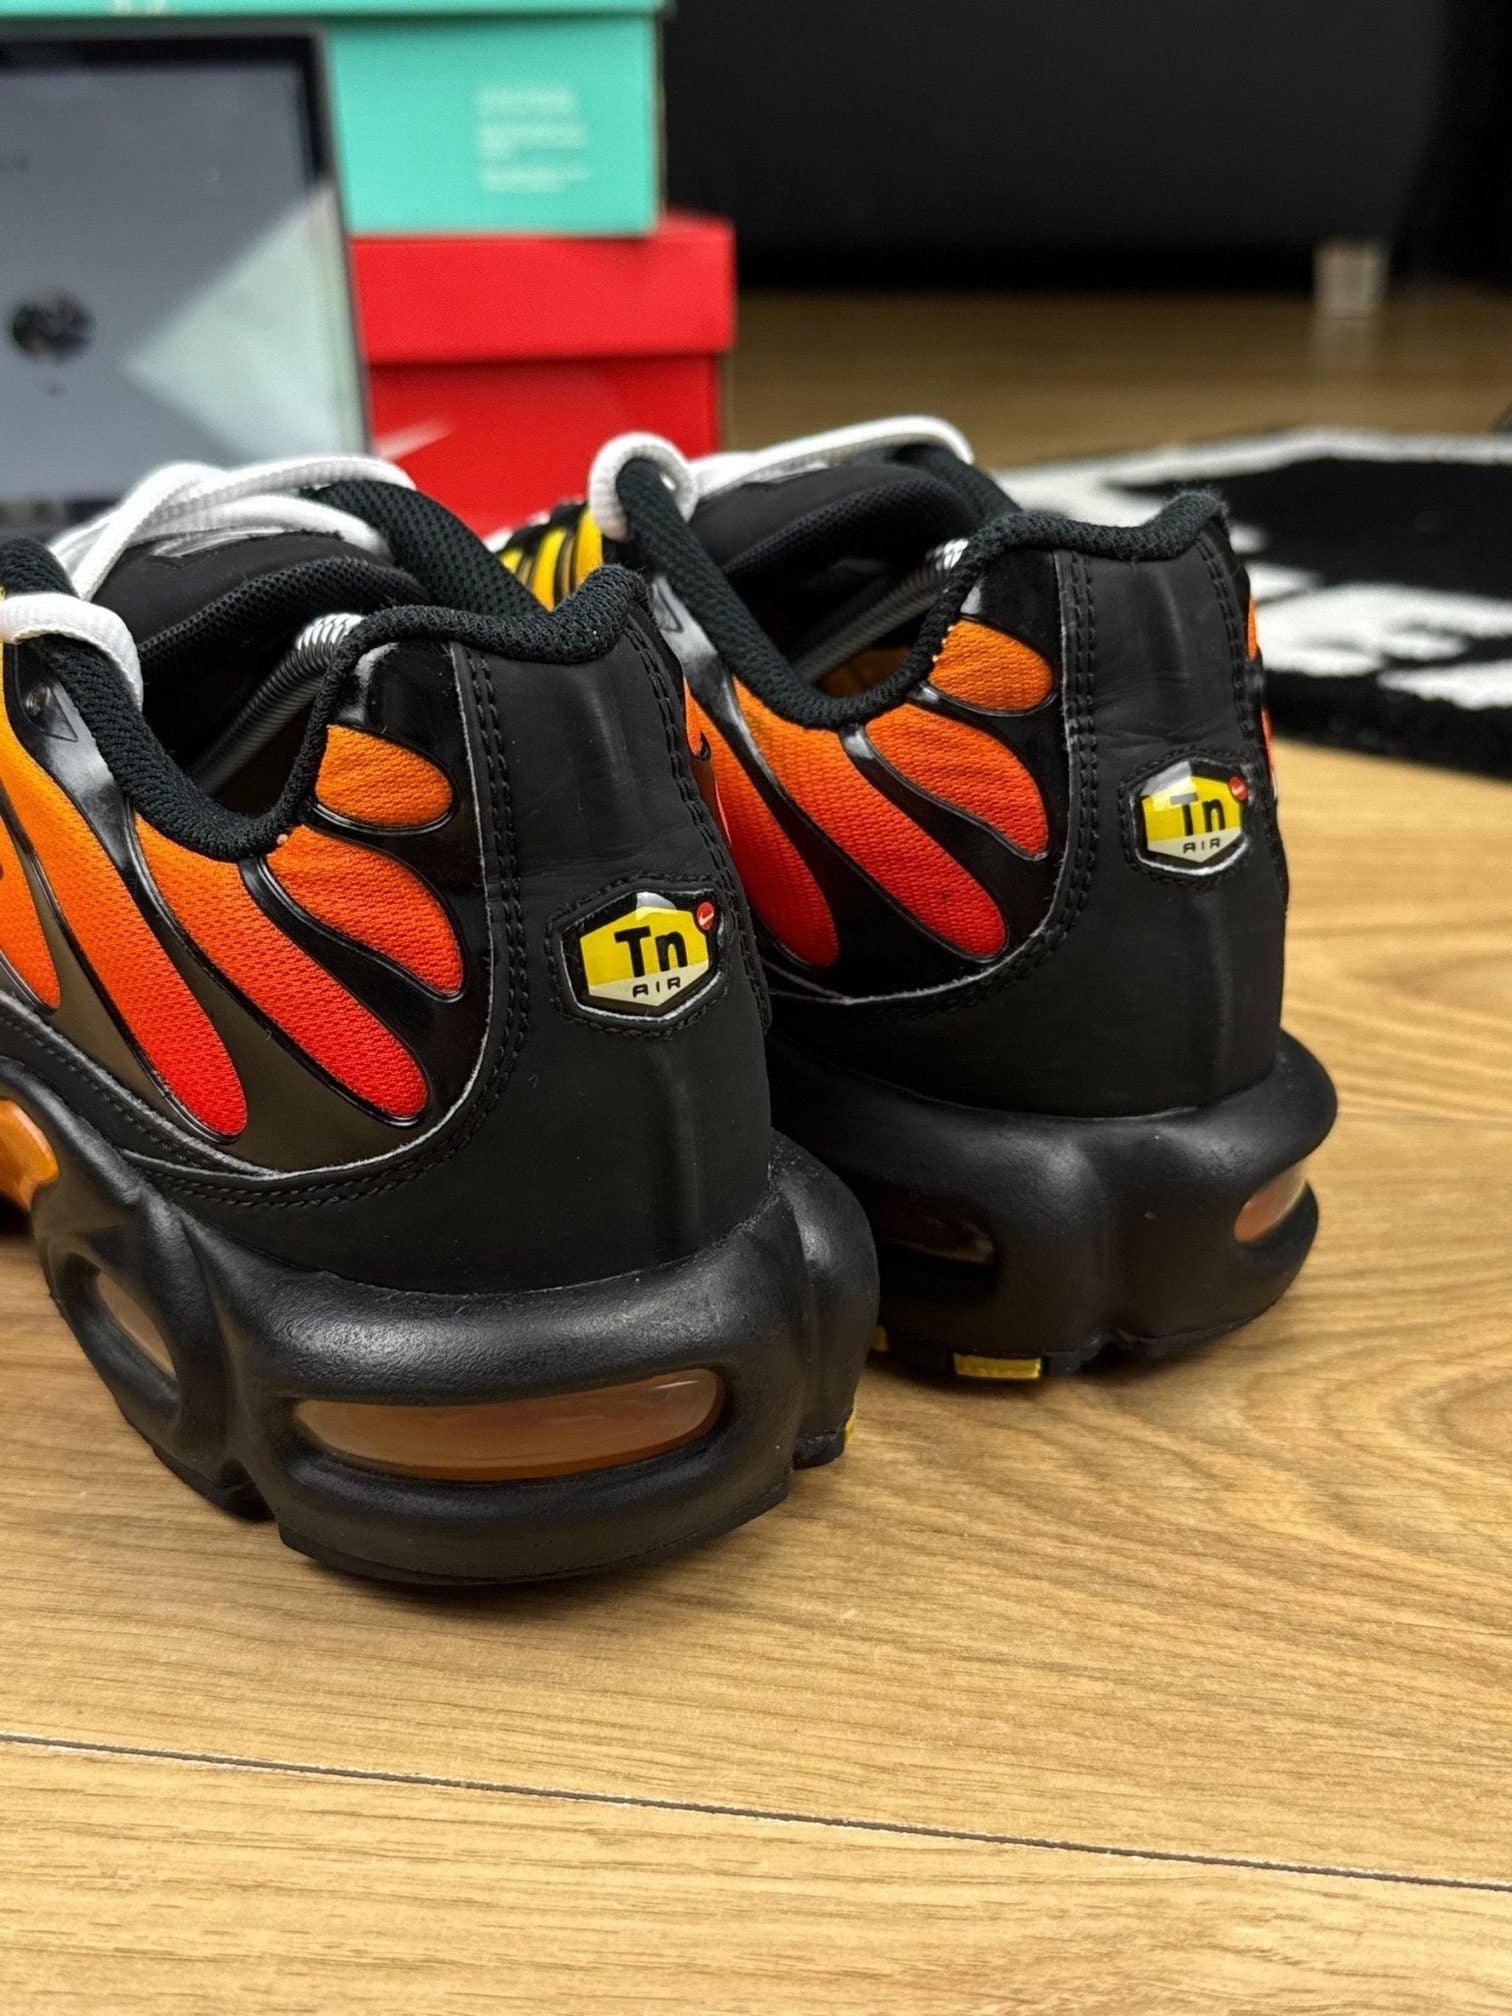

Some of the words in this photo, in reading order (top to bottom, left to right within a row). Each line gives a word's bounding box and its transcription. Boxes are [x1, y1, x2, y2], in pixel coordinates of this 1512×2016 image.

[1169, 793, 1226, 837] Tn
[1183, 838, 1221, 854] AIR
[614, 926, 689, 978] Tn
[632, 977, 682, 998] AIR
